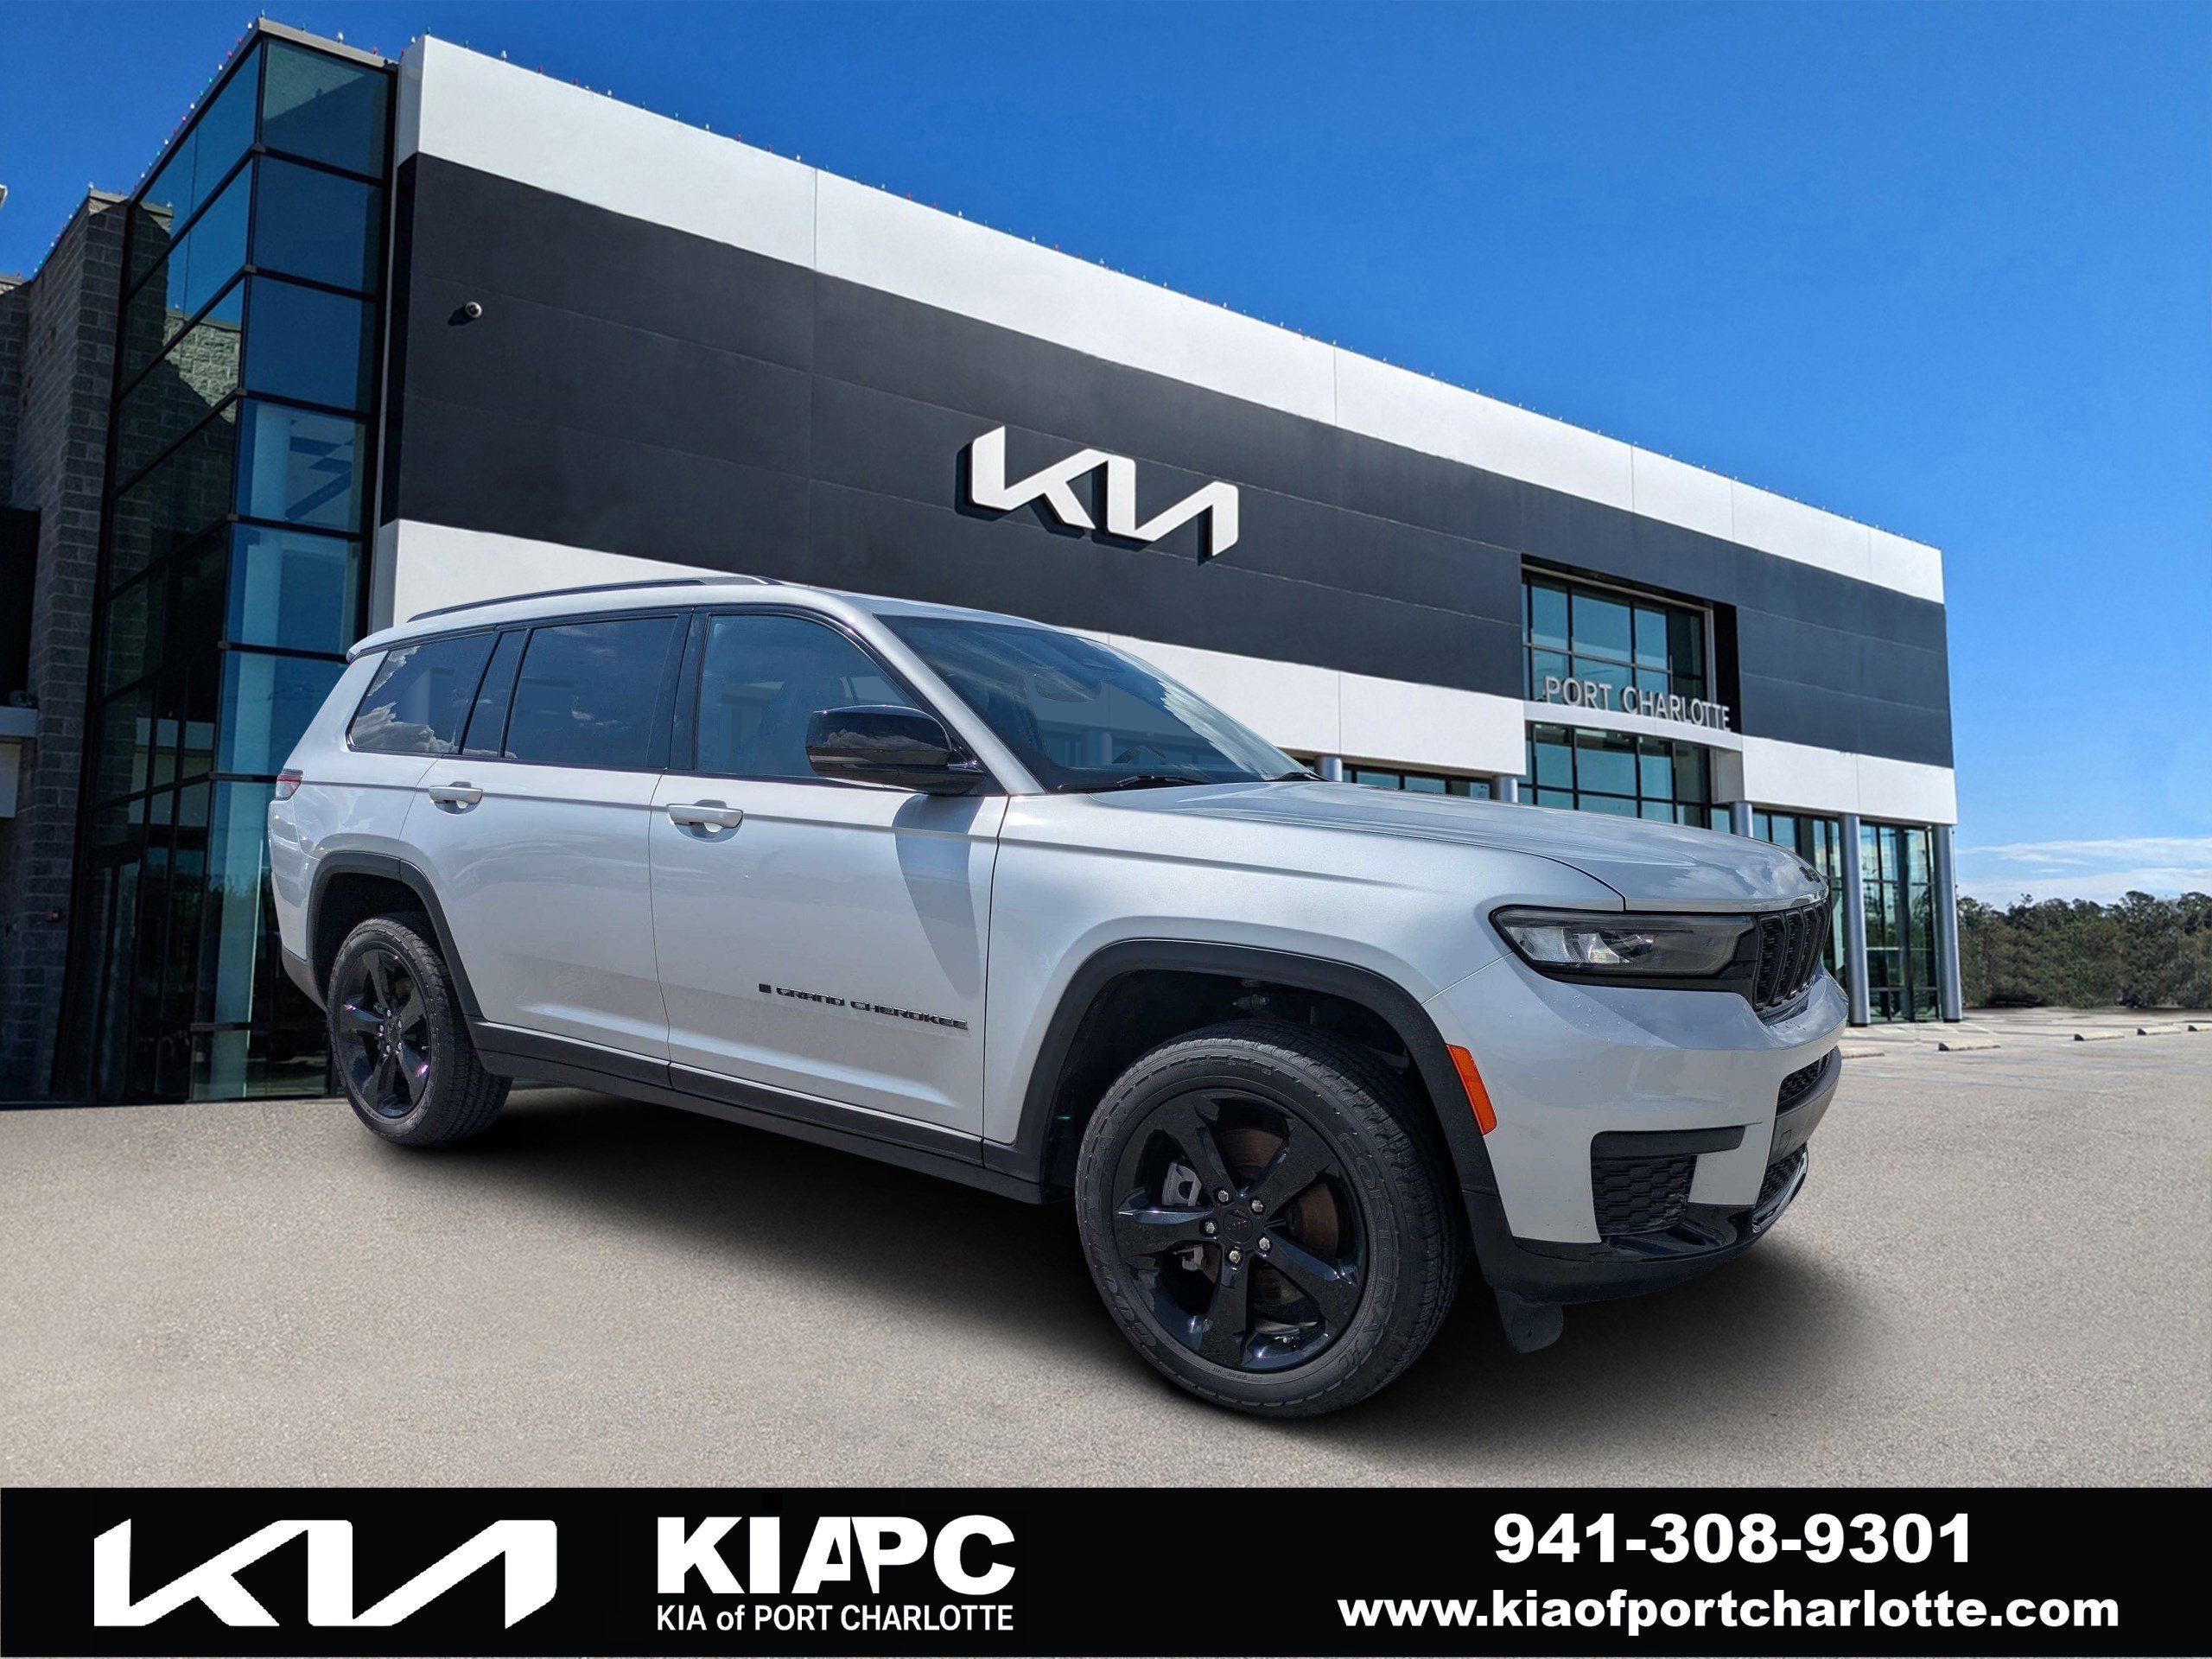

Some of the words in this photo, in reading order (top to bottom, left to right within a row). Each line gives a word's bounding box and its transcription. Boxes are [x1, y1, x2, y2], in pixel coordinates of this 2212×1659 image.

[971, 425, 1239, 556] KIA
[1544, 676, 1612, 711] PORT
[1621, 685, 1731, 732] CHARLOTTE
[776, 987, 845, 1007] GRAND
[850, 1000, 968, 1030] CHEROKEE
